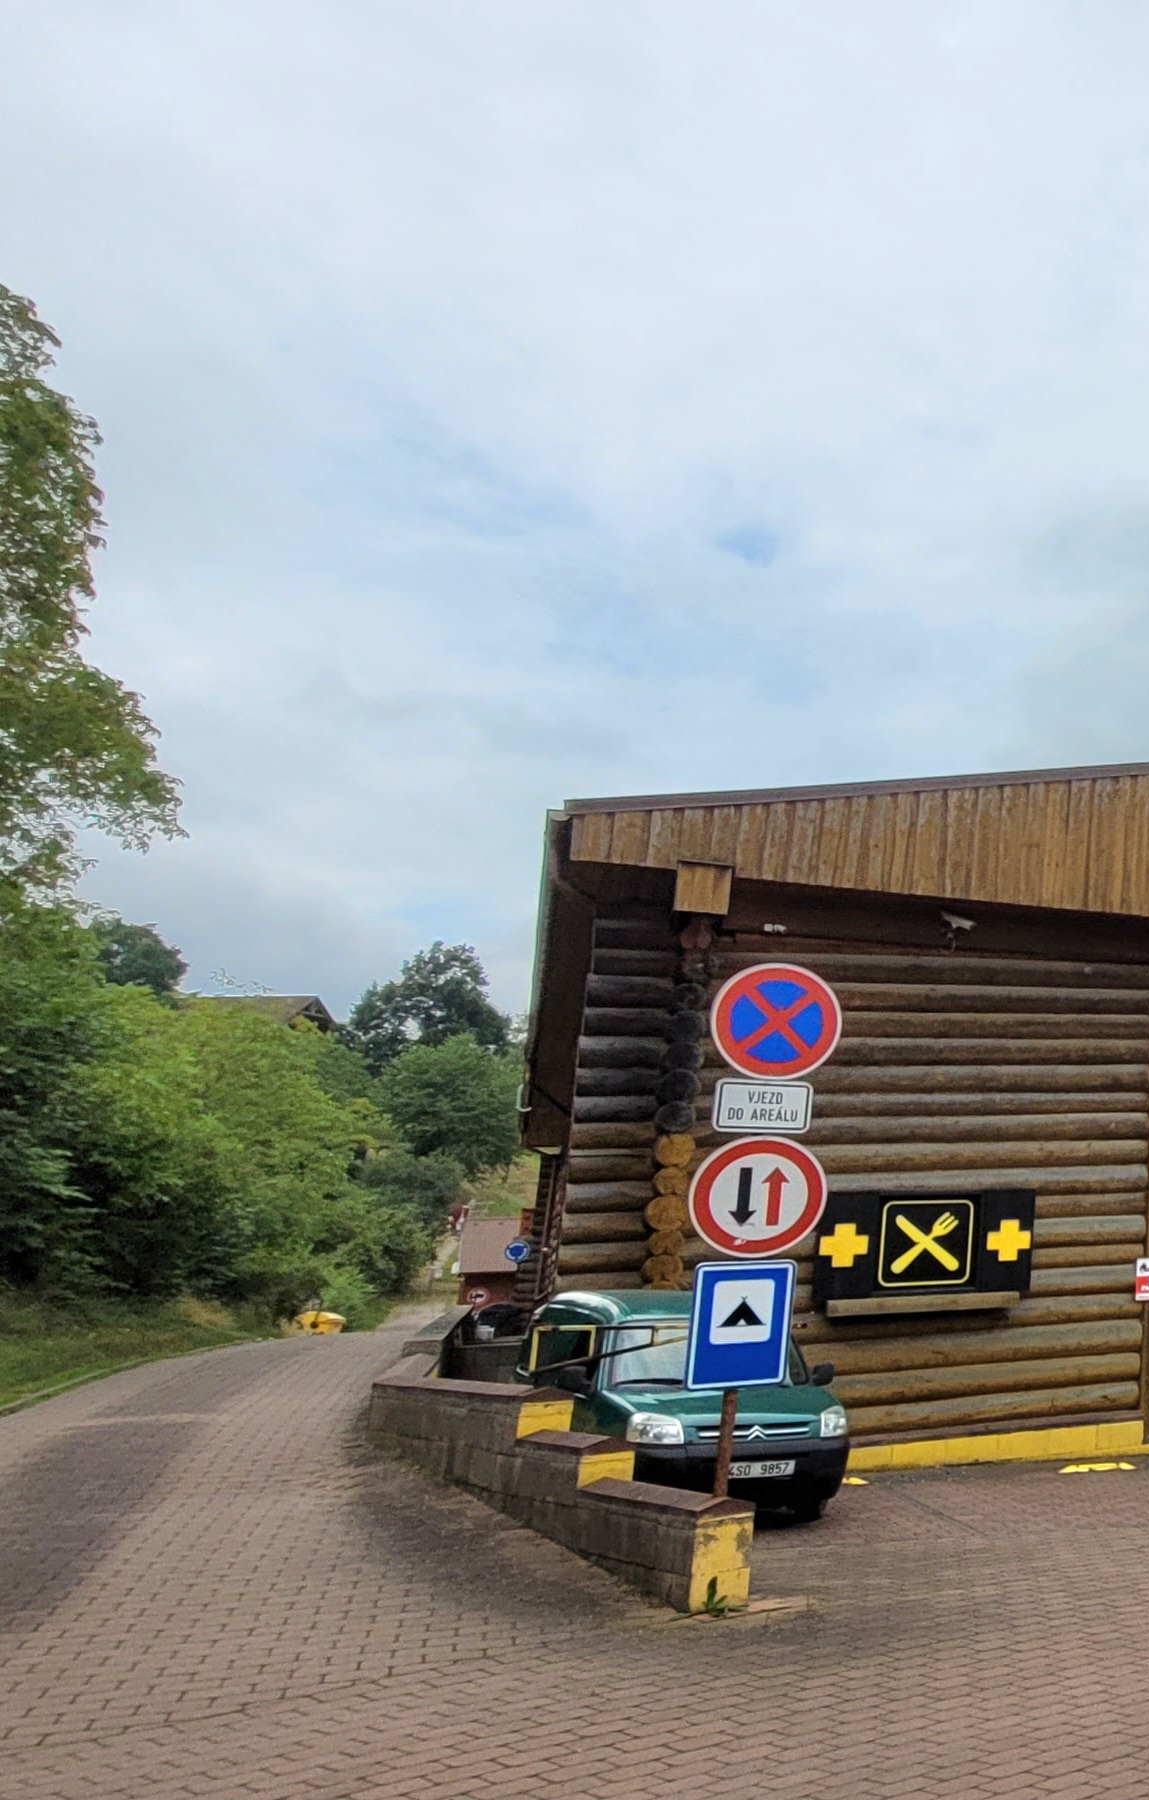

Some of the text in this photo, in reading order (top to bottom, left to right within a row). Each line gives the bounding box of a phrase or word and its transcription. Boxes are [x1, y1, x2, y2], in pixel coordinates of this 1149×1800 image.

[747, 1090, 784, 1105] VJEZD
[727, 1106, 798, 1122] DO AREÁLU
[760, 1462, 790, 1475] 9857
